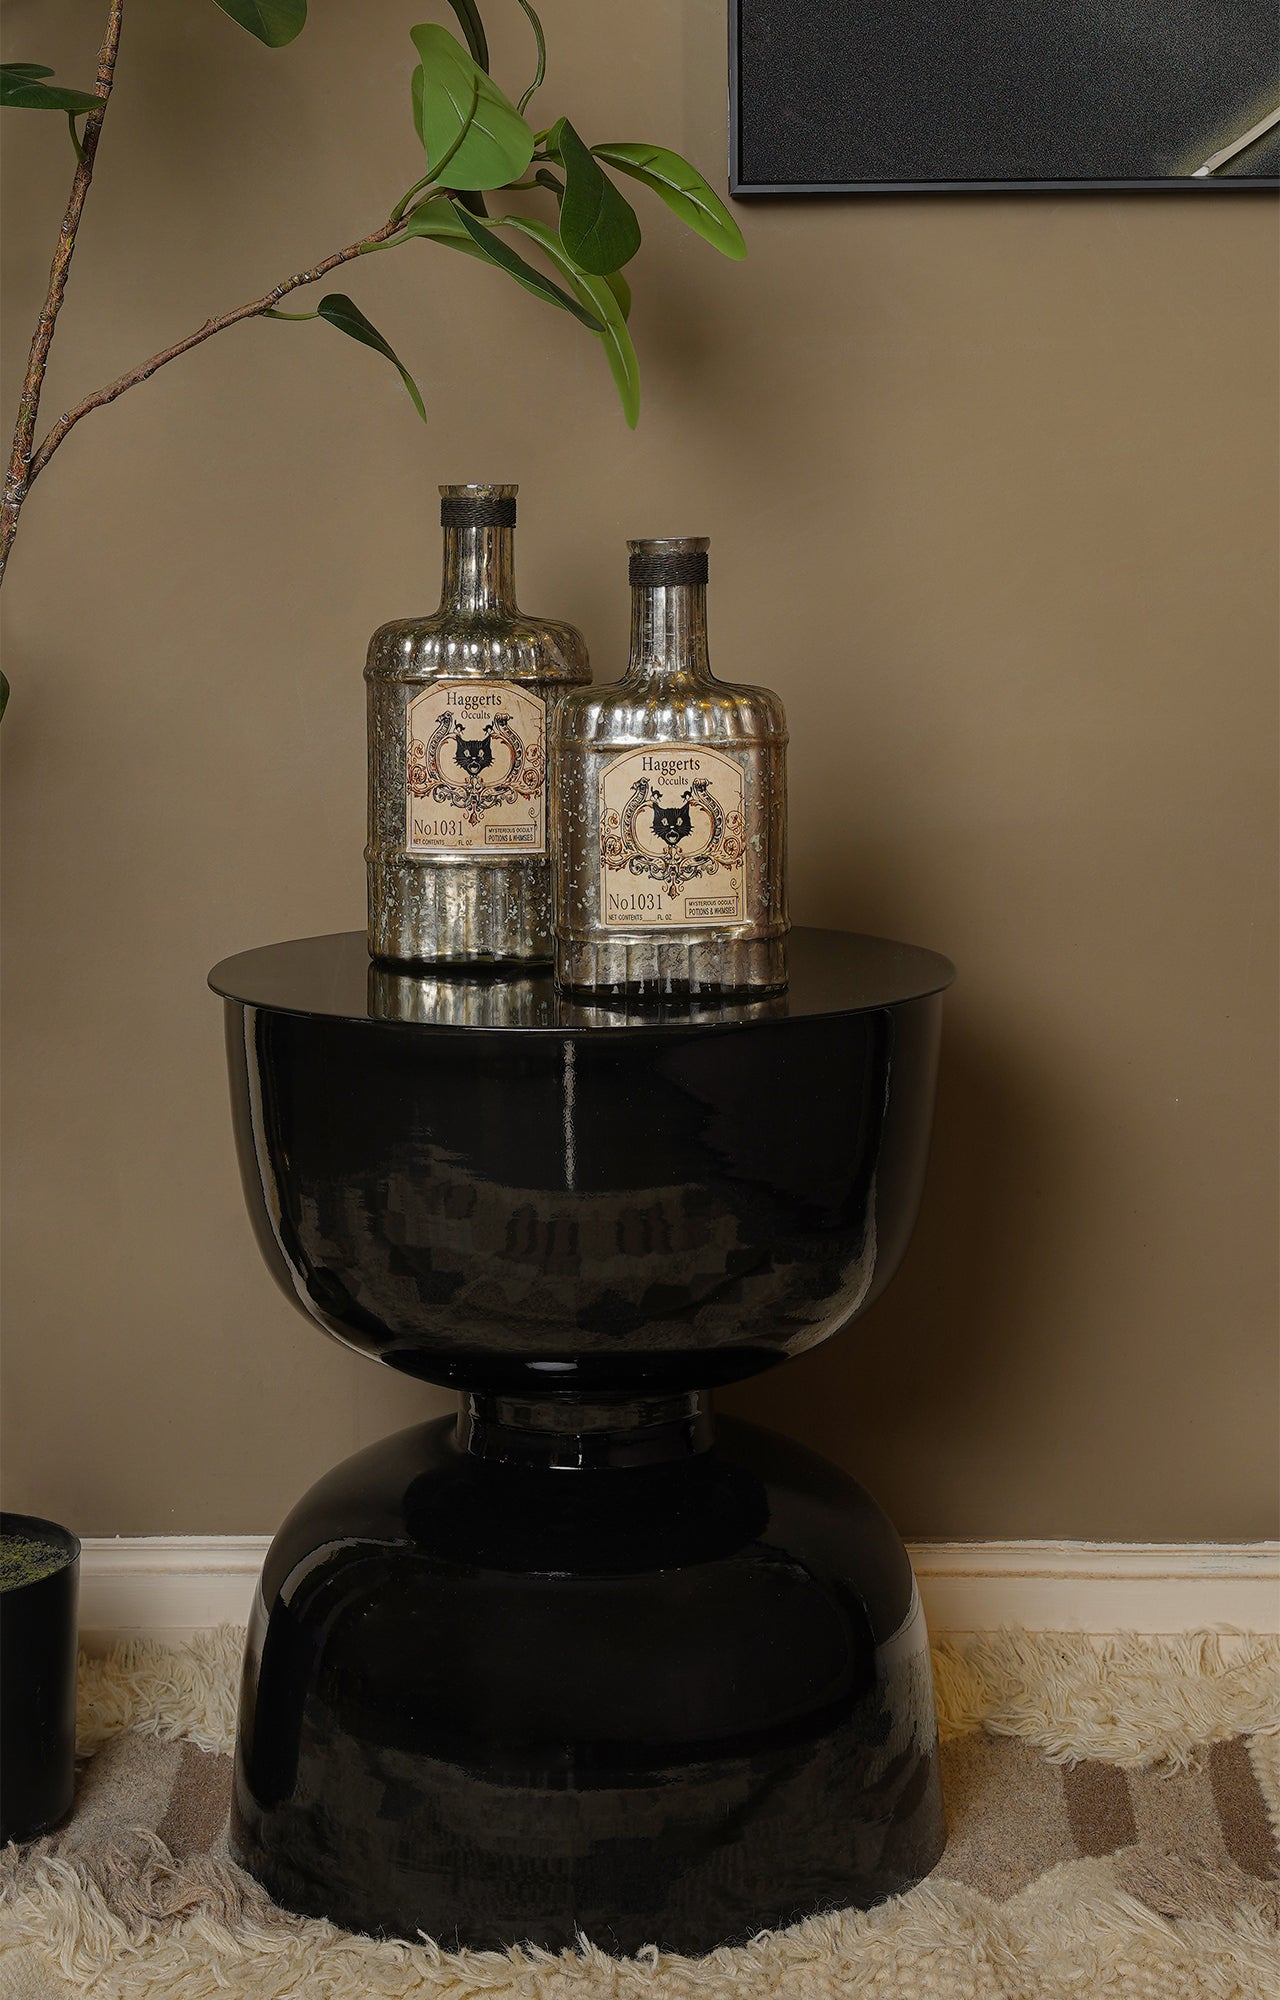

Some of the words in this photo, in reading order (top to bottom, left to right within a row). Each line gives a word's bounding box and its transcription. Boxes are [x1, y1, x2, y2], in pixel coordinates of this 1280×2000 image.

[447, 692, 502, 710] Haggerts
[461, 710, 491, 720] Occults
[642, 757, 701, 775] Haggerts
[658, 776, 689, 786] Occults
[414, 819, 464, 836] No1031
[609, 893, 662, 910] No1031
[688, 908, 710, 916] POTIONS
